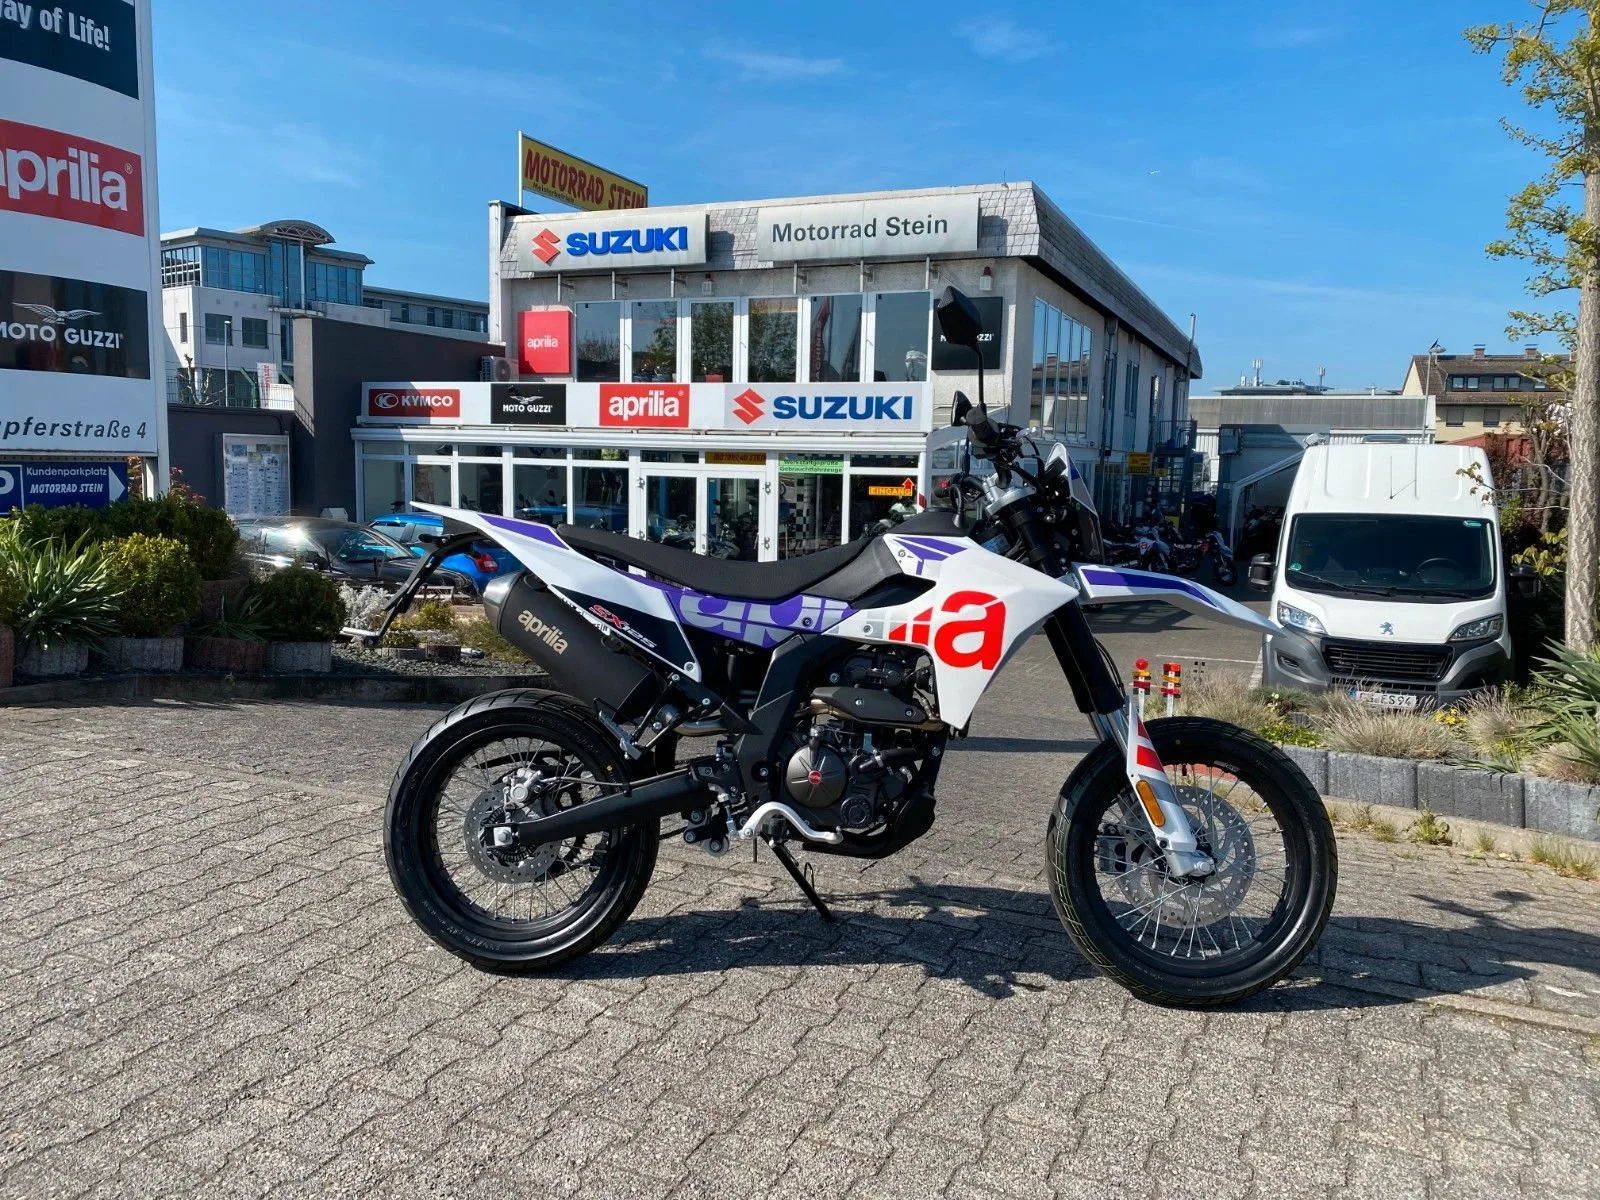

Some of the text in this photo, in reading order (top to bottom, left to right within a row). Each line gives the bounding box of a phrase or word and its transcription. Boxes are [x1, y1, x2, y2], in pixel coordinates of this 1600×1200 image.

[0, 0, 110, 51] ay of Life!
[0, 147, 128, 212] prilia
[524, 148, 604, 205] MOTORRAD
[566, 226, 688, 256] SUZUKI
[772, 215, 948, 243] Motorrad Stein
[64, 327, 120, 349] GUZZI
[527, 335, 559, 349] aprilia
[401, 395, 453, 407] KYMCO
[503, 404, 552, 413] MOTO GUZZI
[609, 390, 680, 421] aprilia
[772, 396, 913, 420] SUZUKI
[0, 416, 147, 440] pferstraße 4
[26, 466, 107, 478] Kundenparkplatz
[30, 483, 103, 494] MOTORRAD STEIN
[871, 487, 912, 496] EINGANG
[517, 609, 569, 656] aprilia
